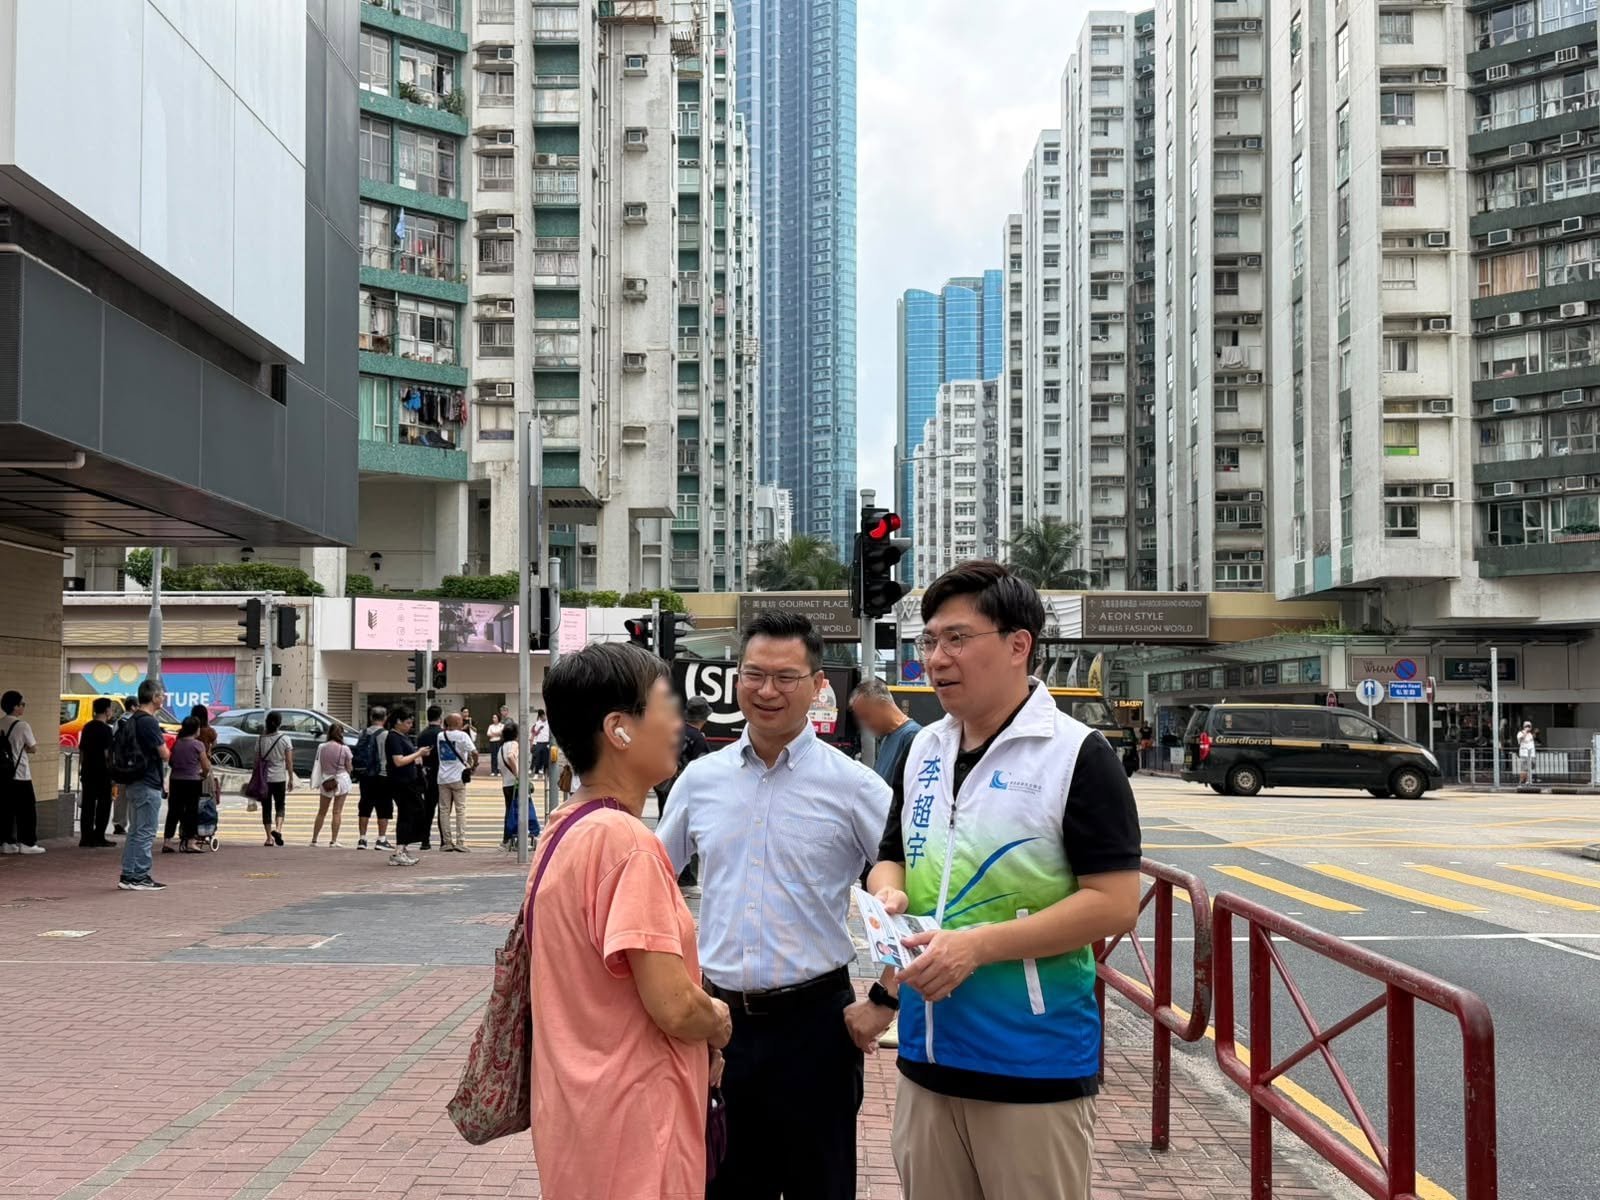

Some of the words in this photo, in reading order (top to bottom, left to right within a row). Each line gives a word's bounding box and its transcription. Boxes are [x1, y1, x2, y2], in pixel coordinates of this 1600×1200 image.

[779, 600, 820, 608] GOURMET
[823, 600, 849, 608] PLACE
[1099, 612, 1131, 621] AEON
[1134, 612, 1164, 621] STYLE
[822, 625, 852, 633] WORLD
[1125, 624, 1162, 632] FASHION
[1164, 624, 1193, 632] WORLD
[1363, 664, 1394, 673] WHAM
[164, 692, 210, 707] TURE
[1119, 700, 1144, 708] BAKERY
[1215, 735, 1271, 745] Guardforce
[906, 755, 941, 868] 李超宇
